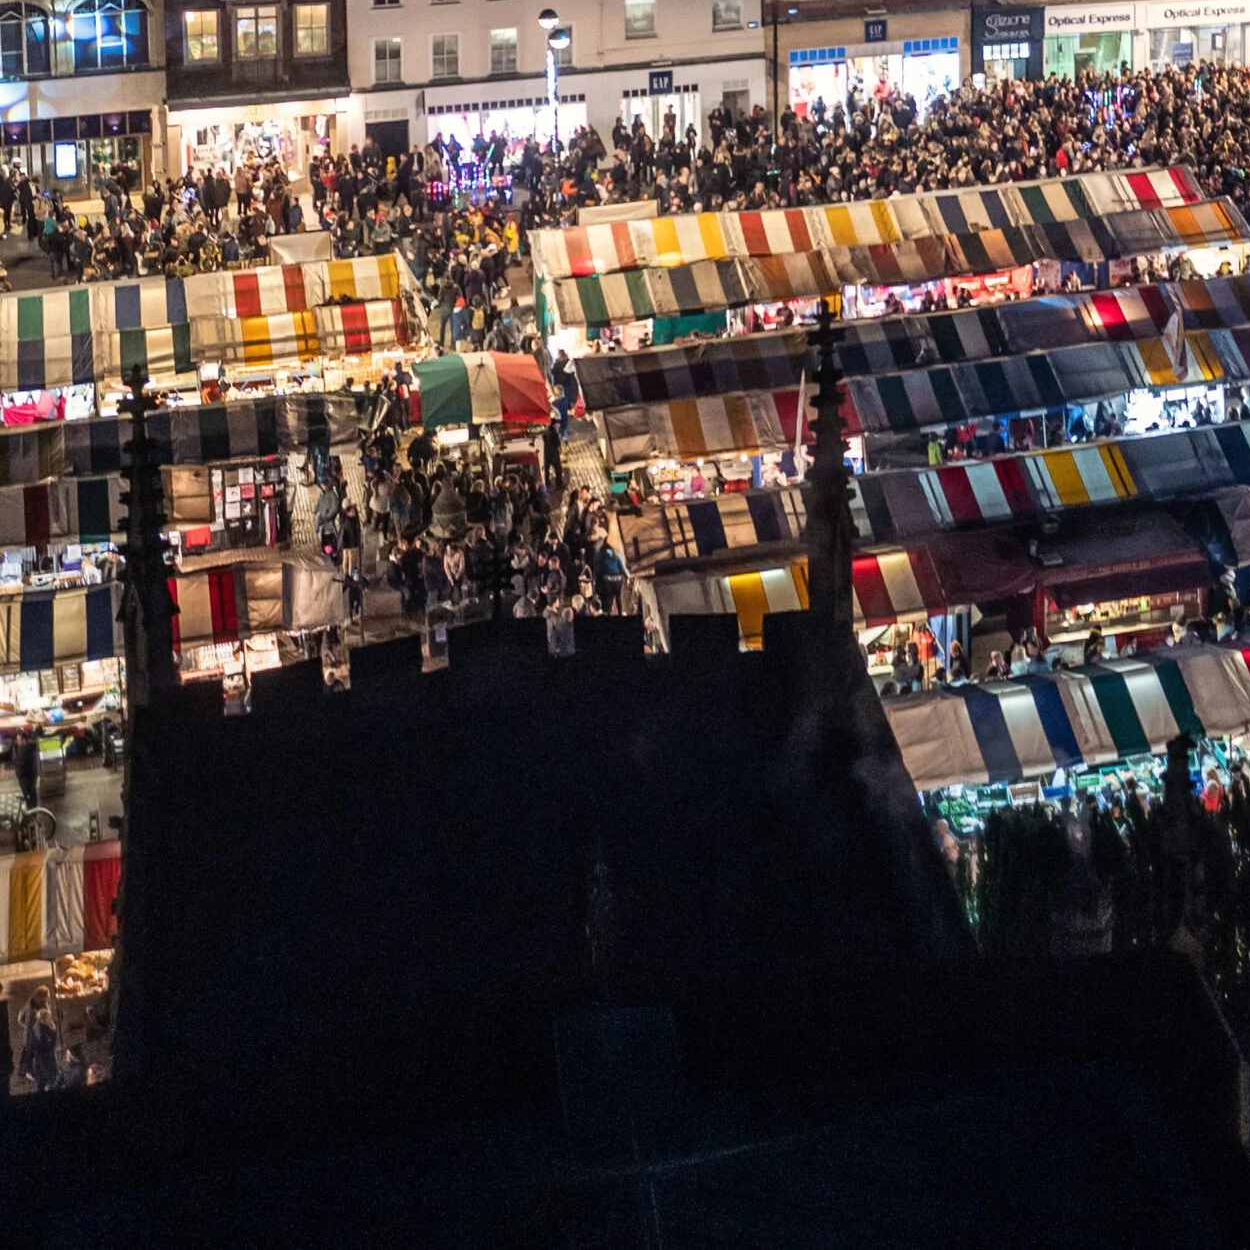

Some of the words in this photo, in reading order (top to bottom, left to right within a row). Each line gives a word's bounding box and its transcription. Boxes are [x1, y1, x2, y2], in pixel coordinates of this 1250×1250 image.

[1164, 6, 1201, 20] Optical
[1204, 6, 1246, 17] Express
[1048, 15, 1086, 27] Optical
[1089, 14, 1131, 25] Express
[652, 76, 669, 90] GAP
